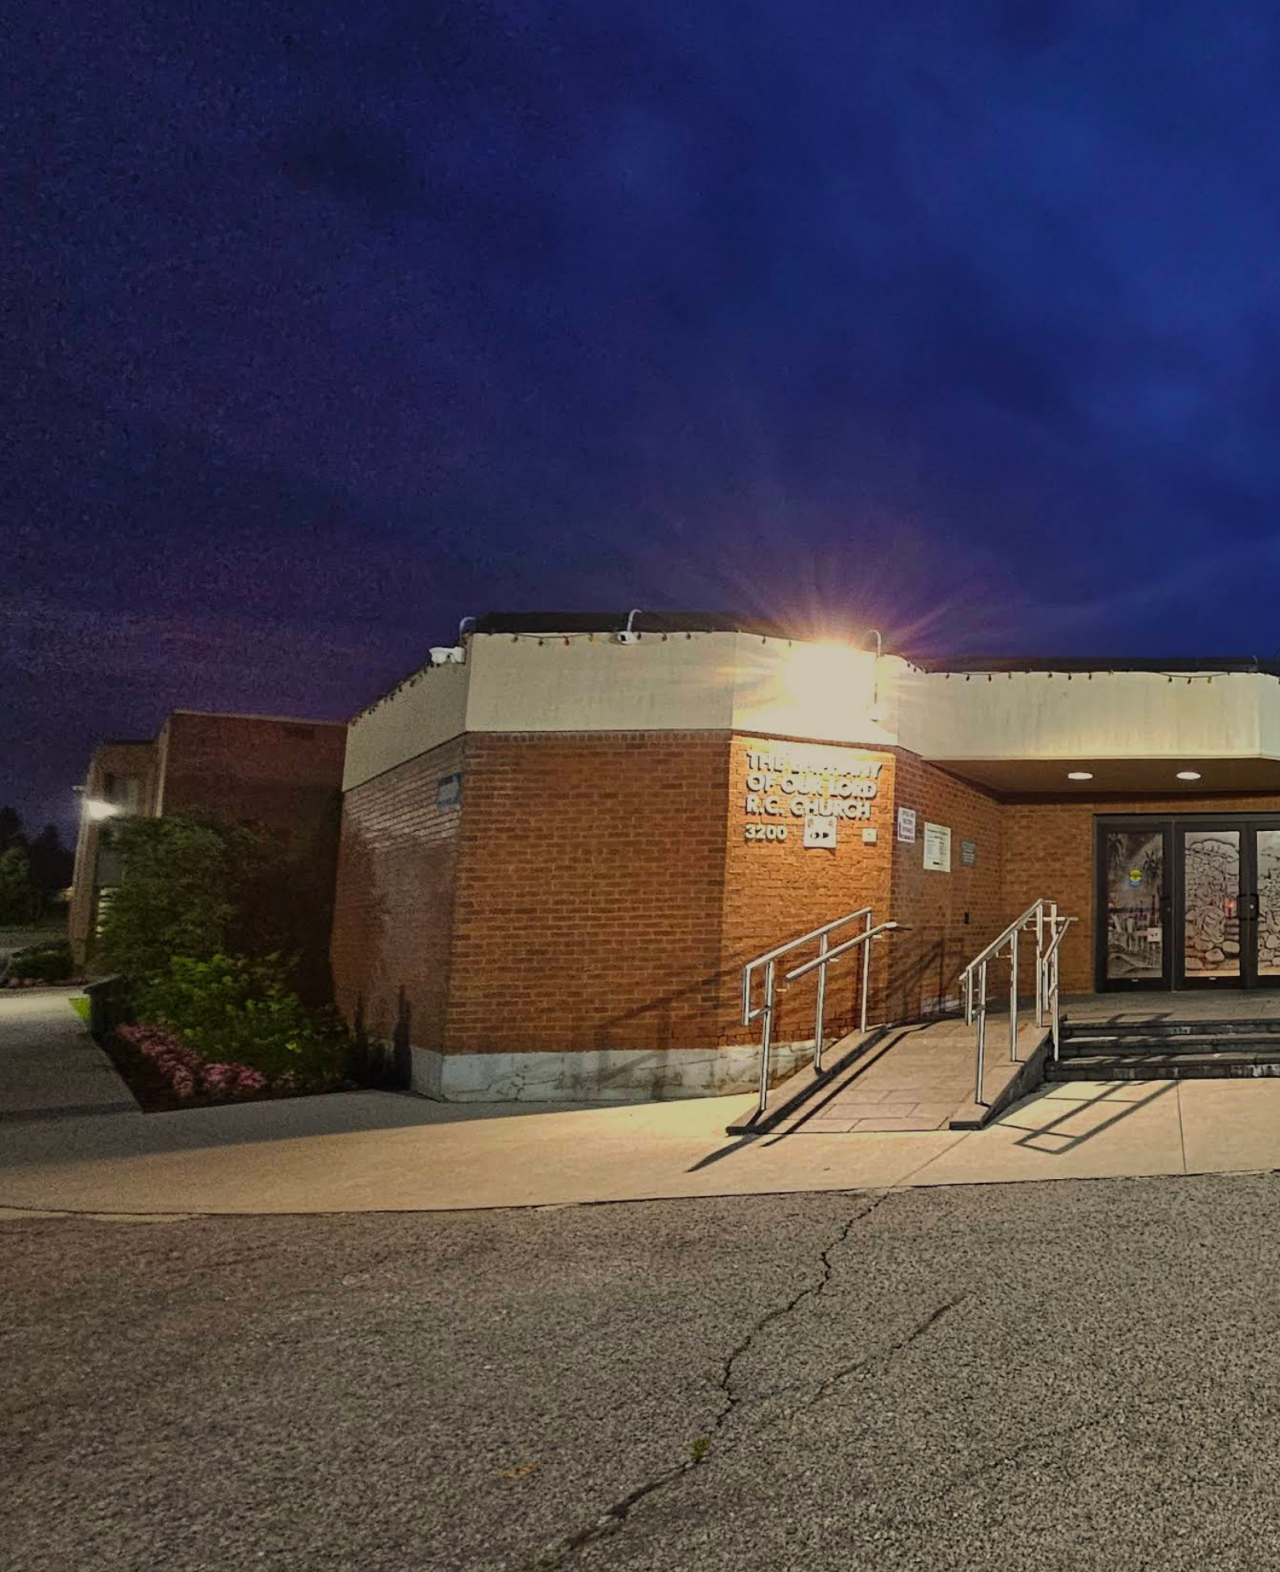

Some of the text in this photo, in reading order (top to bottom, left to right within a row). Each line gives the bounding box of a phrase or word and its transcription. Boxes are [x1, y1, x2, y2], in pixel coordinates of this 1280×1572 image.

[746, 753, 783, 773] THE
[746, 774, 878, 801] OF OUR LORD
[745, 795, 872, 821] R.C. CHURCH
[744, 823, 788, 842] 3200
